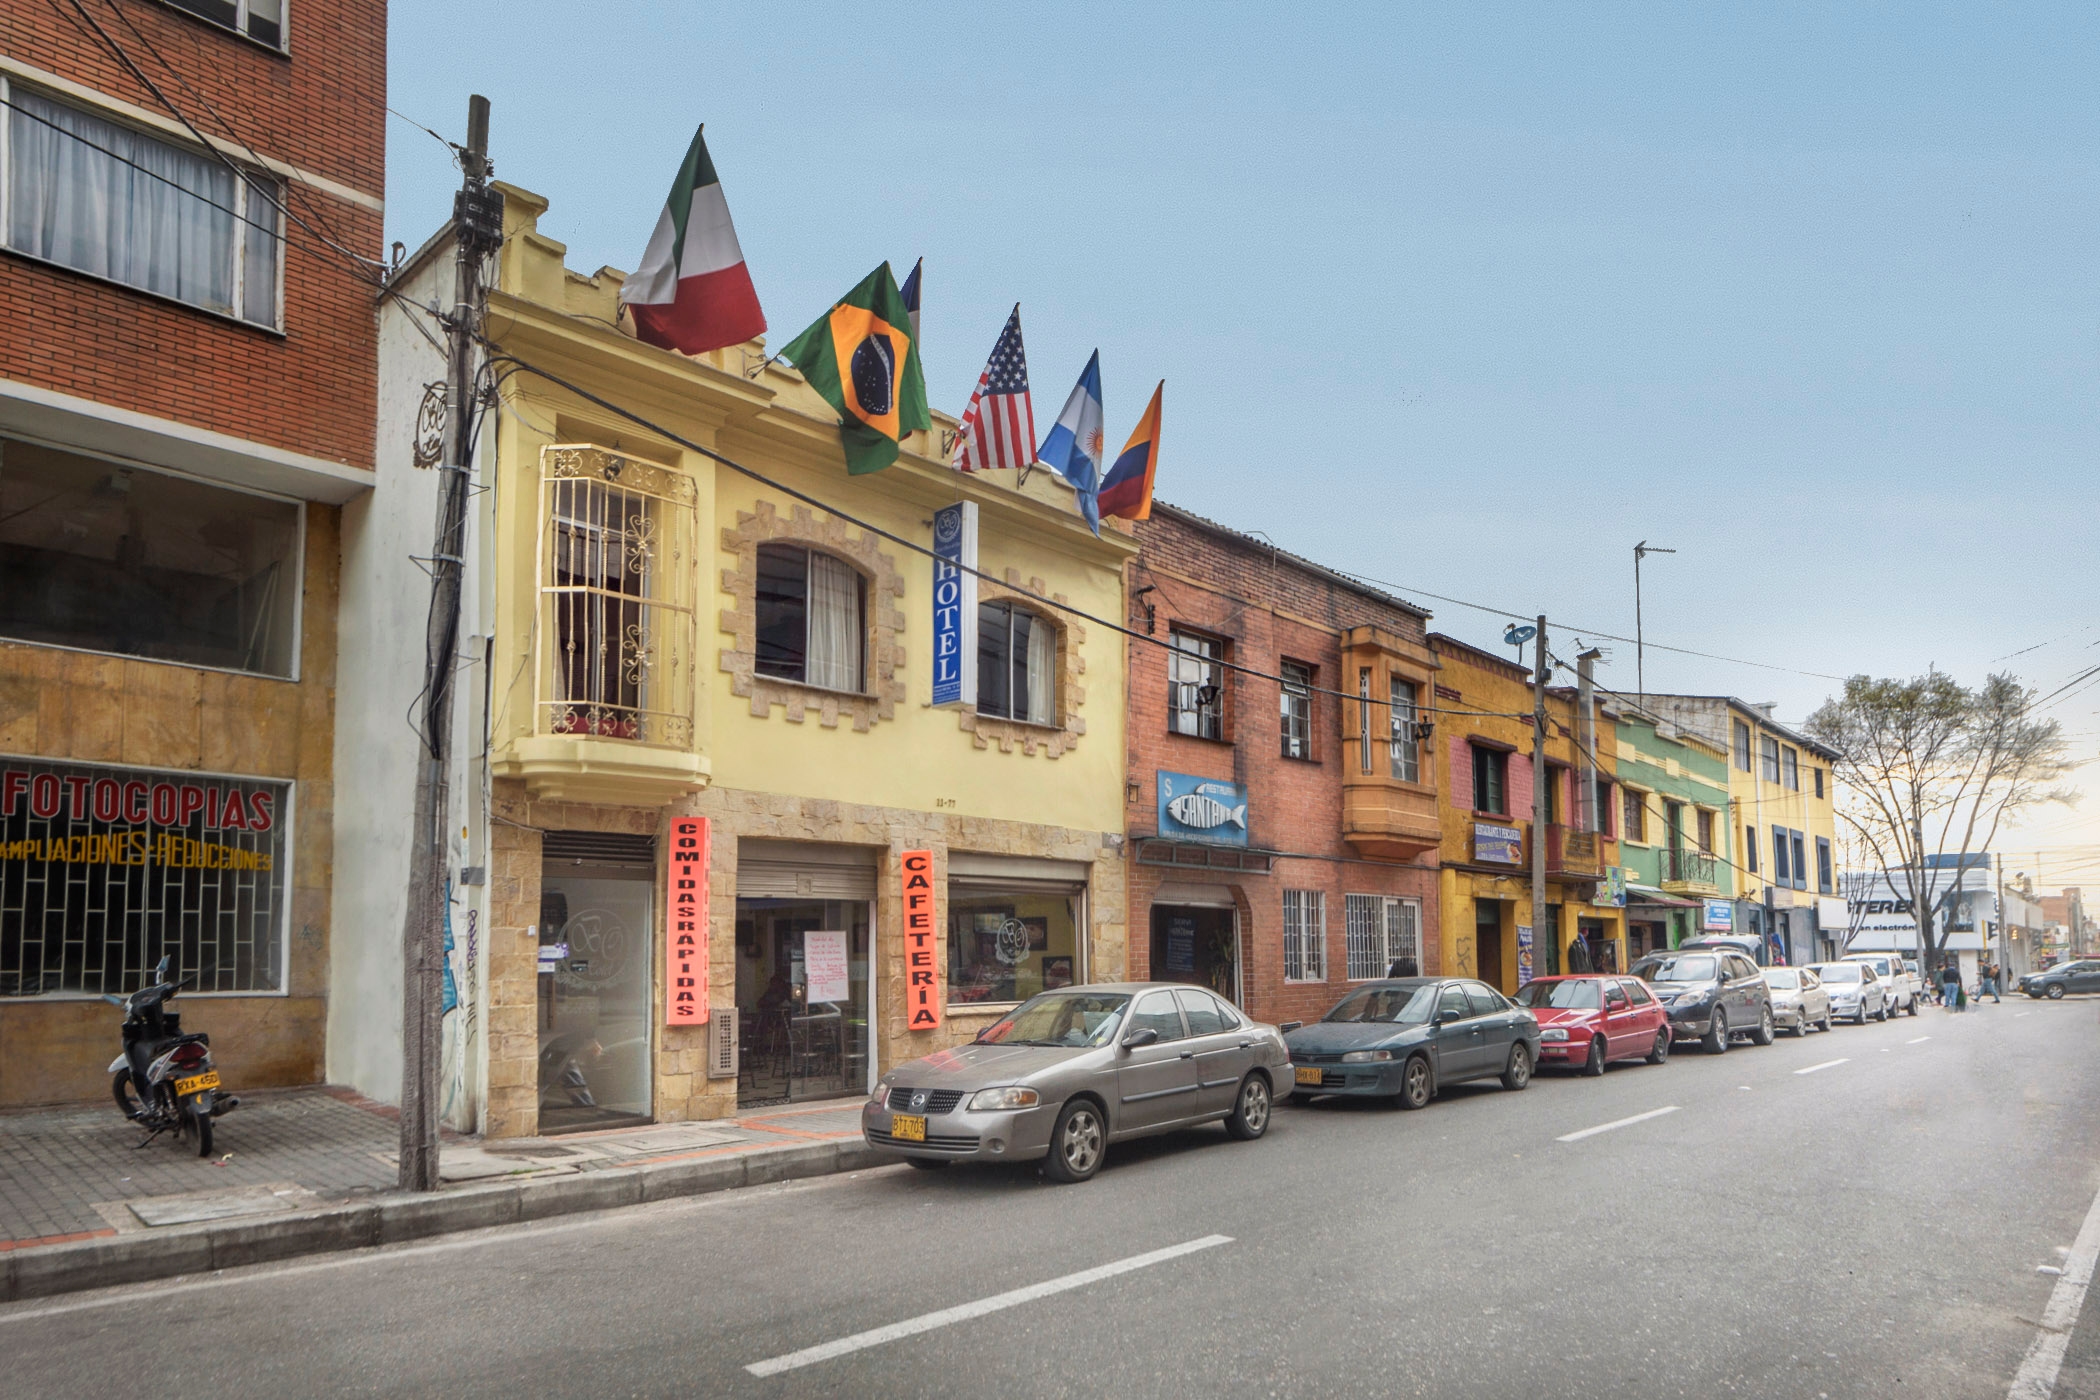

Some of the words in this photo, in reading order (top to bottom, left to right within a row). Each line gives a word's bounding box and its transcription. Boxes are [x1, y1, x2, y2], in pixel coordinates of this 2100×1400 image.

[936, 553, 959, 682] HOTEL
[0, 831, 147, 866] AMPLIACIONES
[2, 770, 274, 832] FOTOCOPIAS
[904, 856, 938, 1025] CAFETERÍA
